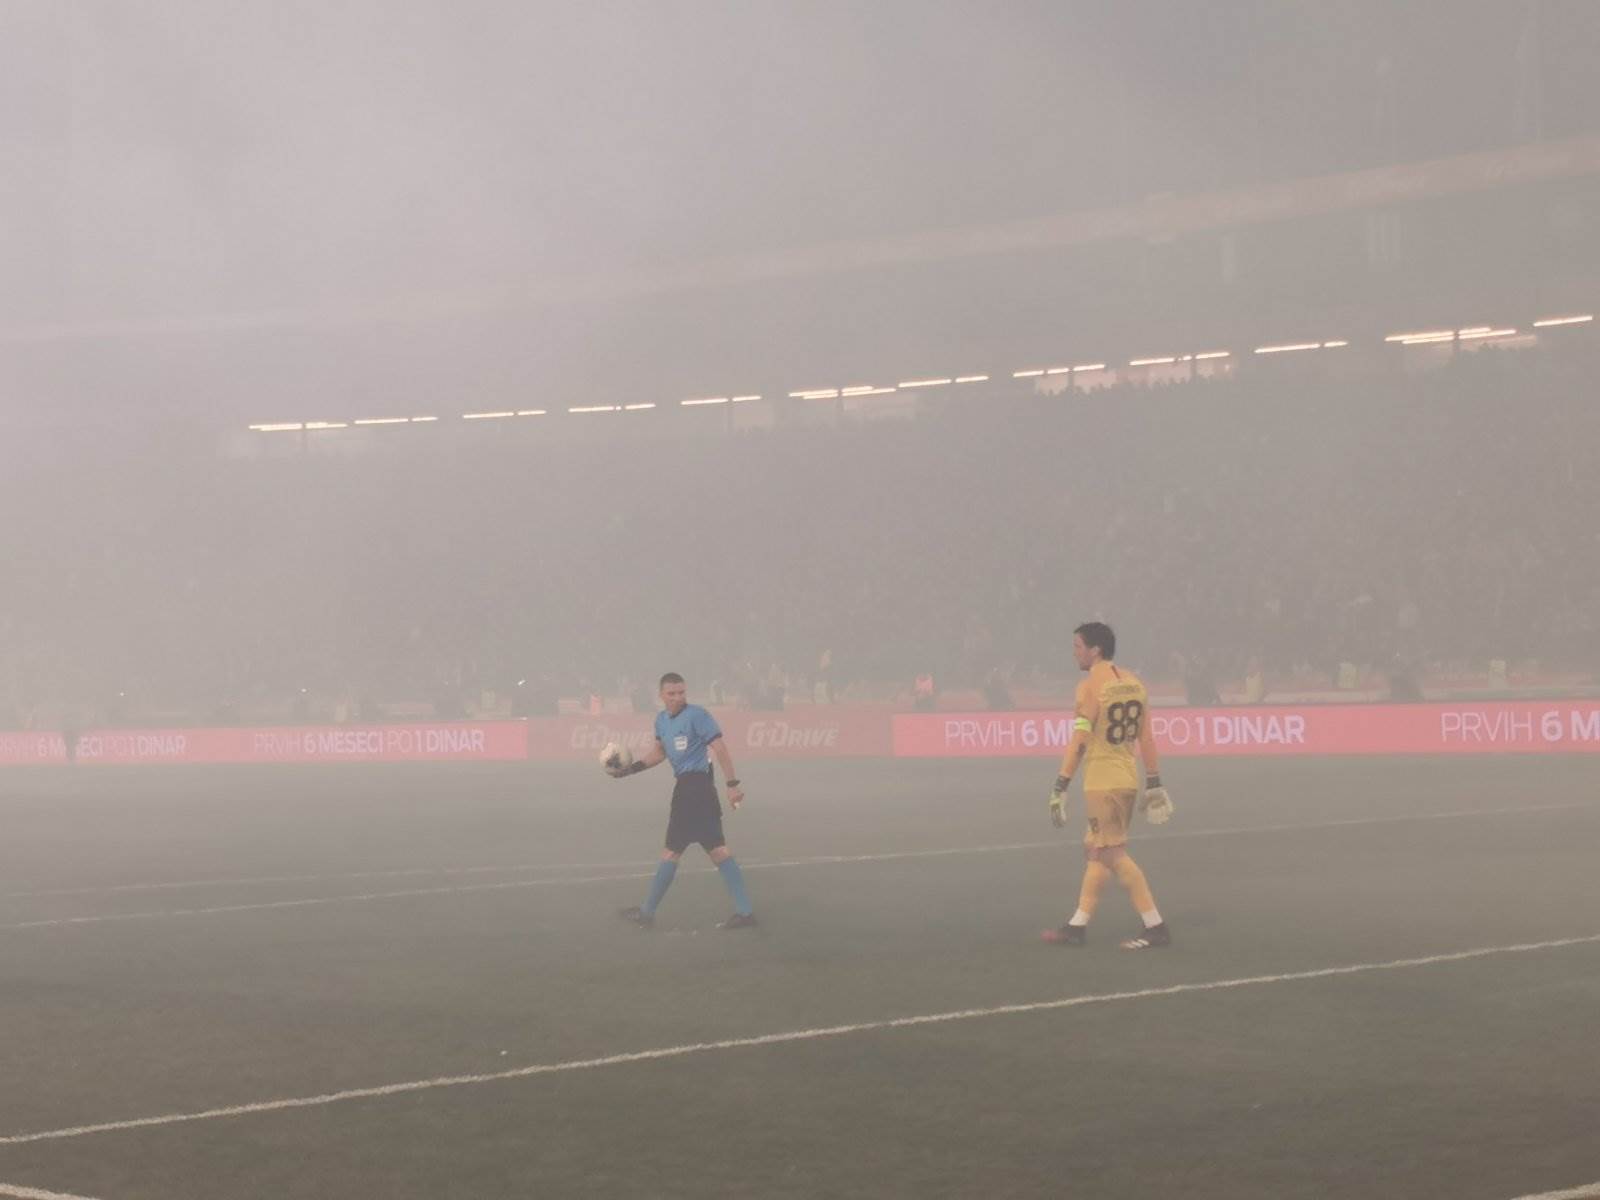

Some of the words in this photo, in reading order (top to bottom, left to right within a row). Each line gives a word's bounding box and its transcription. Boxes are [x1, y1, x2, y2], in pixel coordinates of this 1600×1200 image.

[944, 719, 1016, 747] PRVIH
[1021, 719, 1039, 747] 6
[1151, 716, 1191, 746] PO
[1212, 714, 1305, 745] DINAR
[1106, 700, 1142, 745] 88
[1440, 711, 1534, 742] PRVIH
[1541, 710, 1563, 742] 6
[304, 732, 317, 753] 6
[318, 730, 383, 753] MESECI
[387, 729, 415, 751] PO
[426, 729, 485, 753] DINAR
